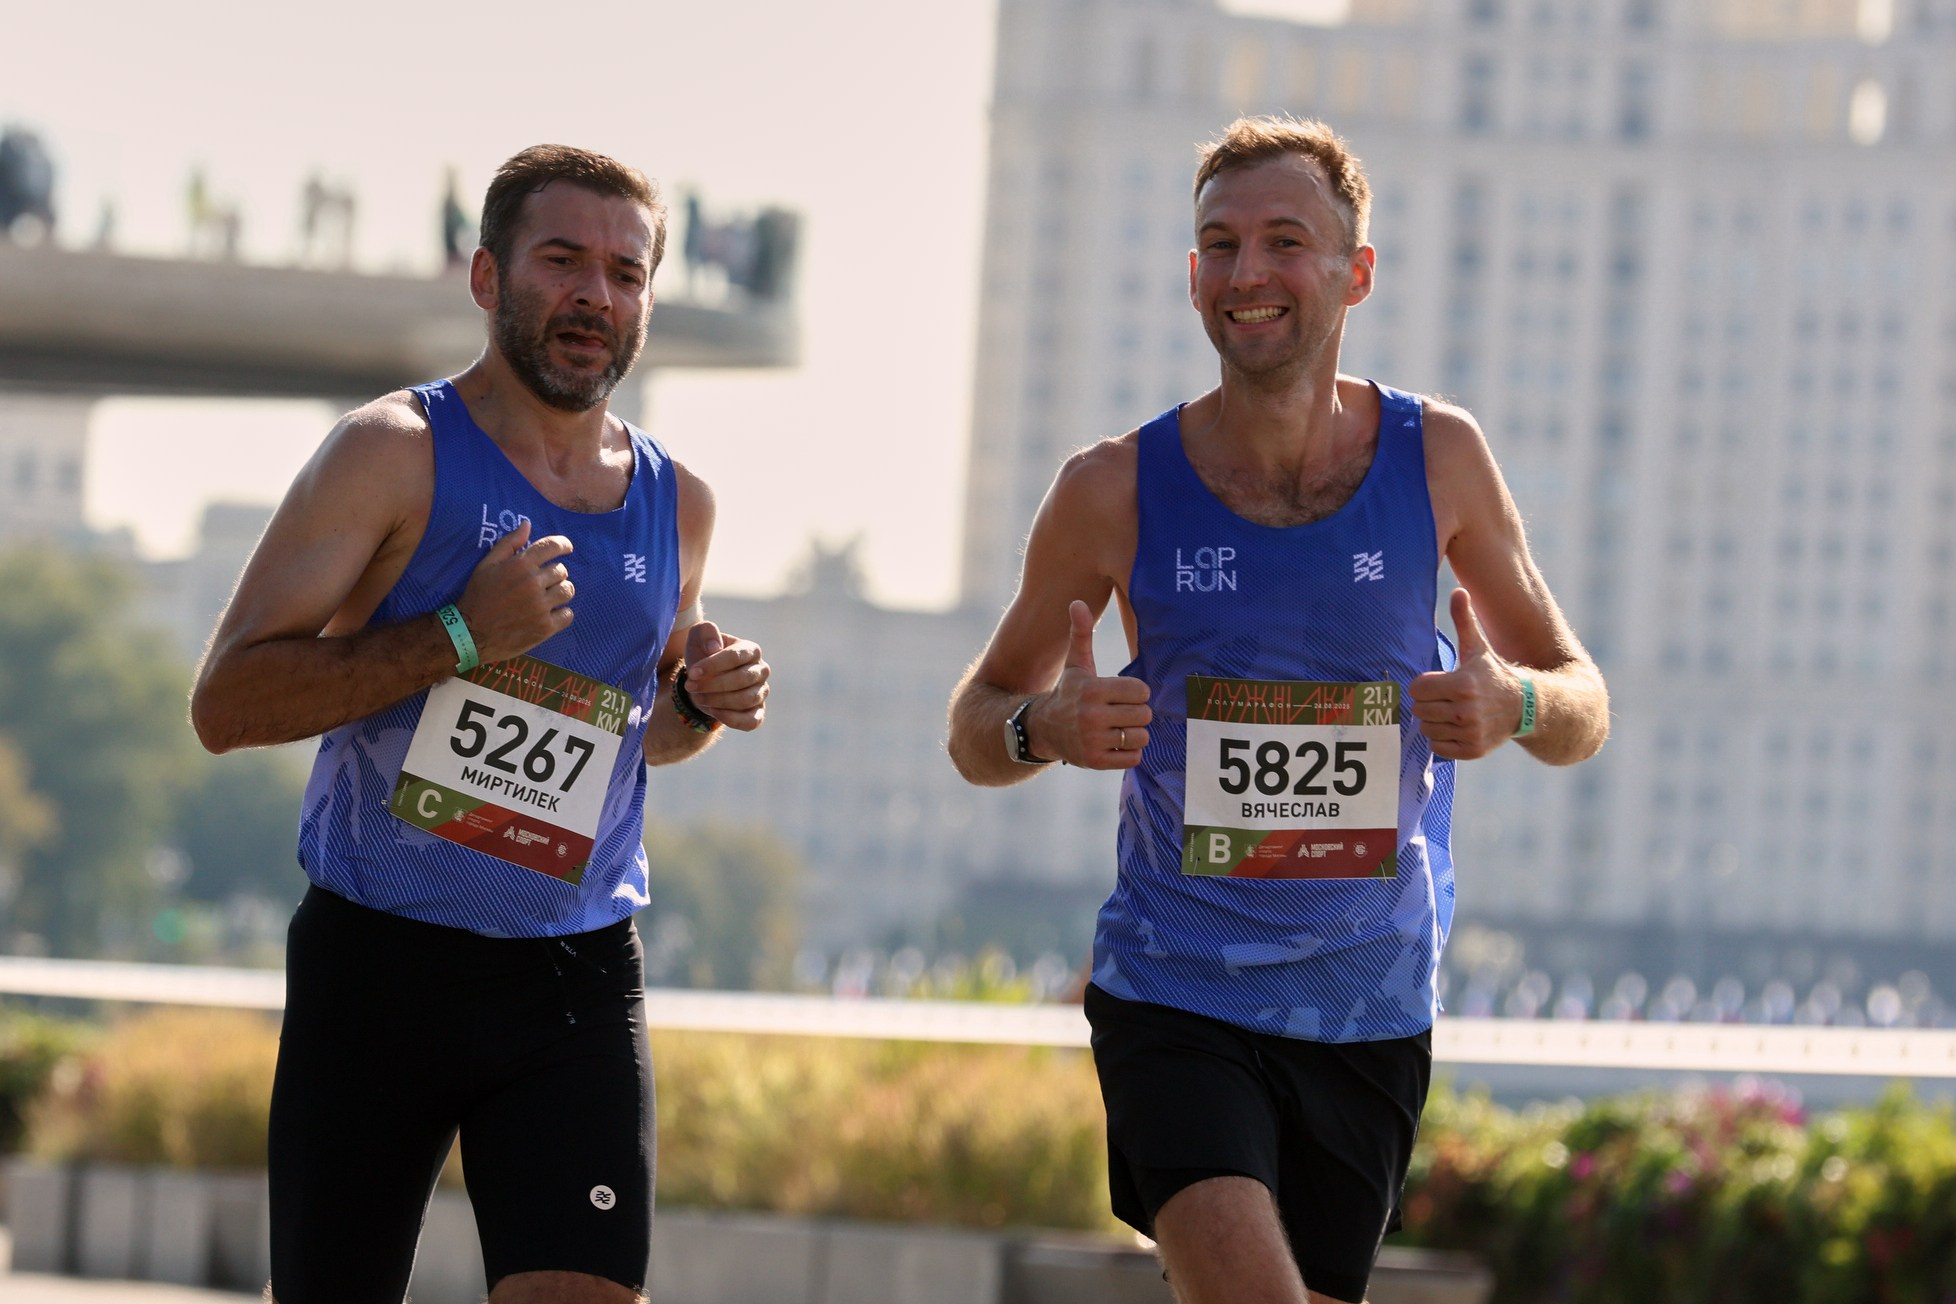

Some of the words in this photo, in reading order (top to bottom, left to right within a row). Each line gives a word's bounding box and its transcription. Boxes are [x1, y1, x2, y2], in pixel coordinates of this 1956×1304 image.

[1176, 570, 1237, 592] RUN
[480, 664, 543, 689] ЛУМАРАФОН
[470, 658, 598, 721] ЖНИКИ
[601, 690, 626, 713] 21,1
[1363, 686, 1393, 706] 21,1
[1207, 699, 1291, 709] ПОЛУМАРАФОН
[450, 699, 595, 792] 5267
[1218, 738, 1367, 795] 5825
[461, 766, 560, 812] МИРТИЛЕК
[1241, 802, 1340, 818] ВЯЧЕСЛАВ
